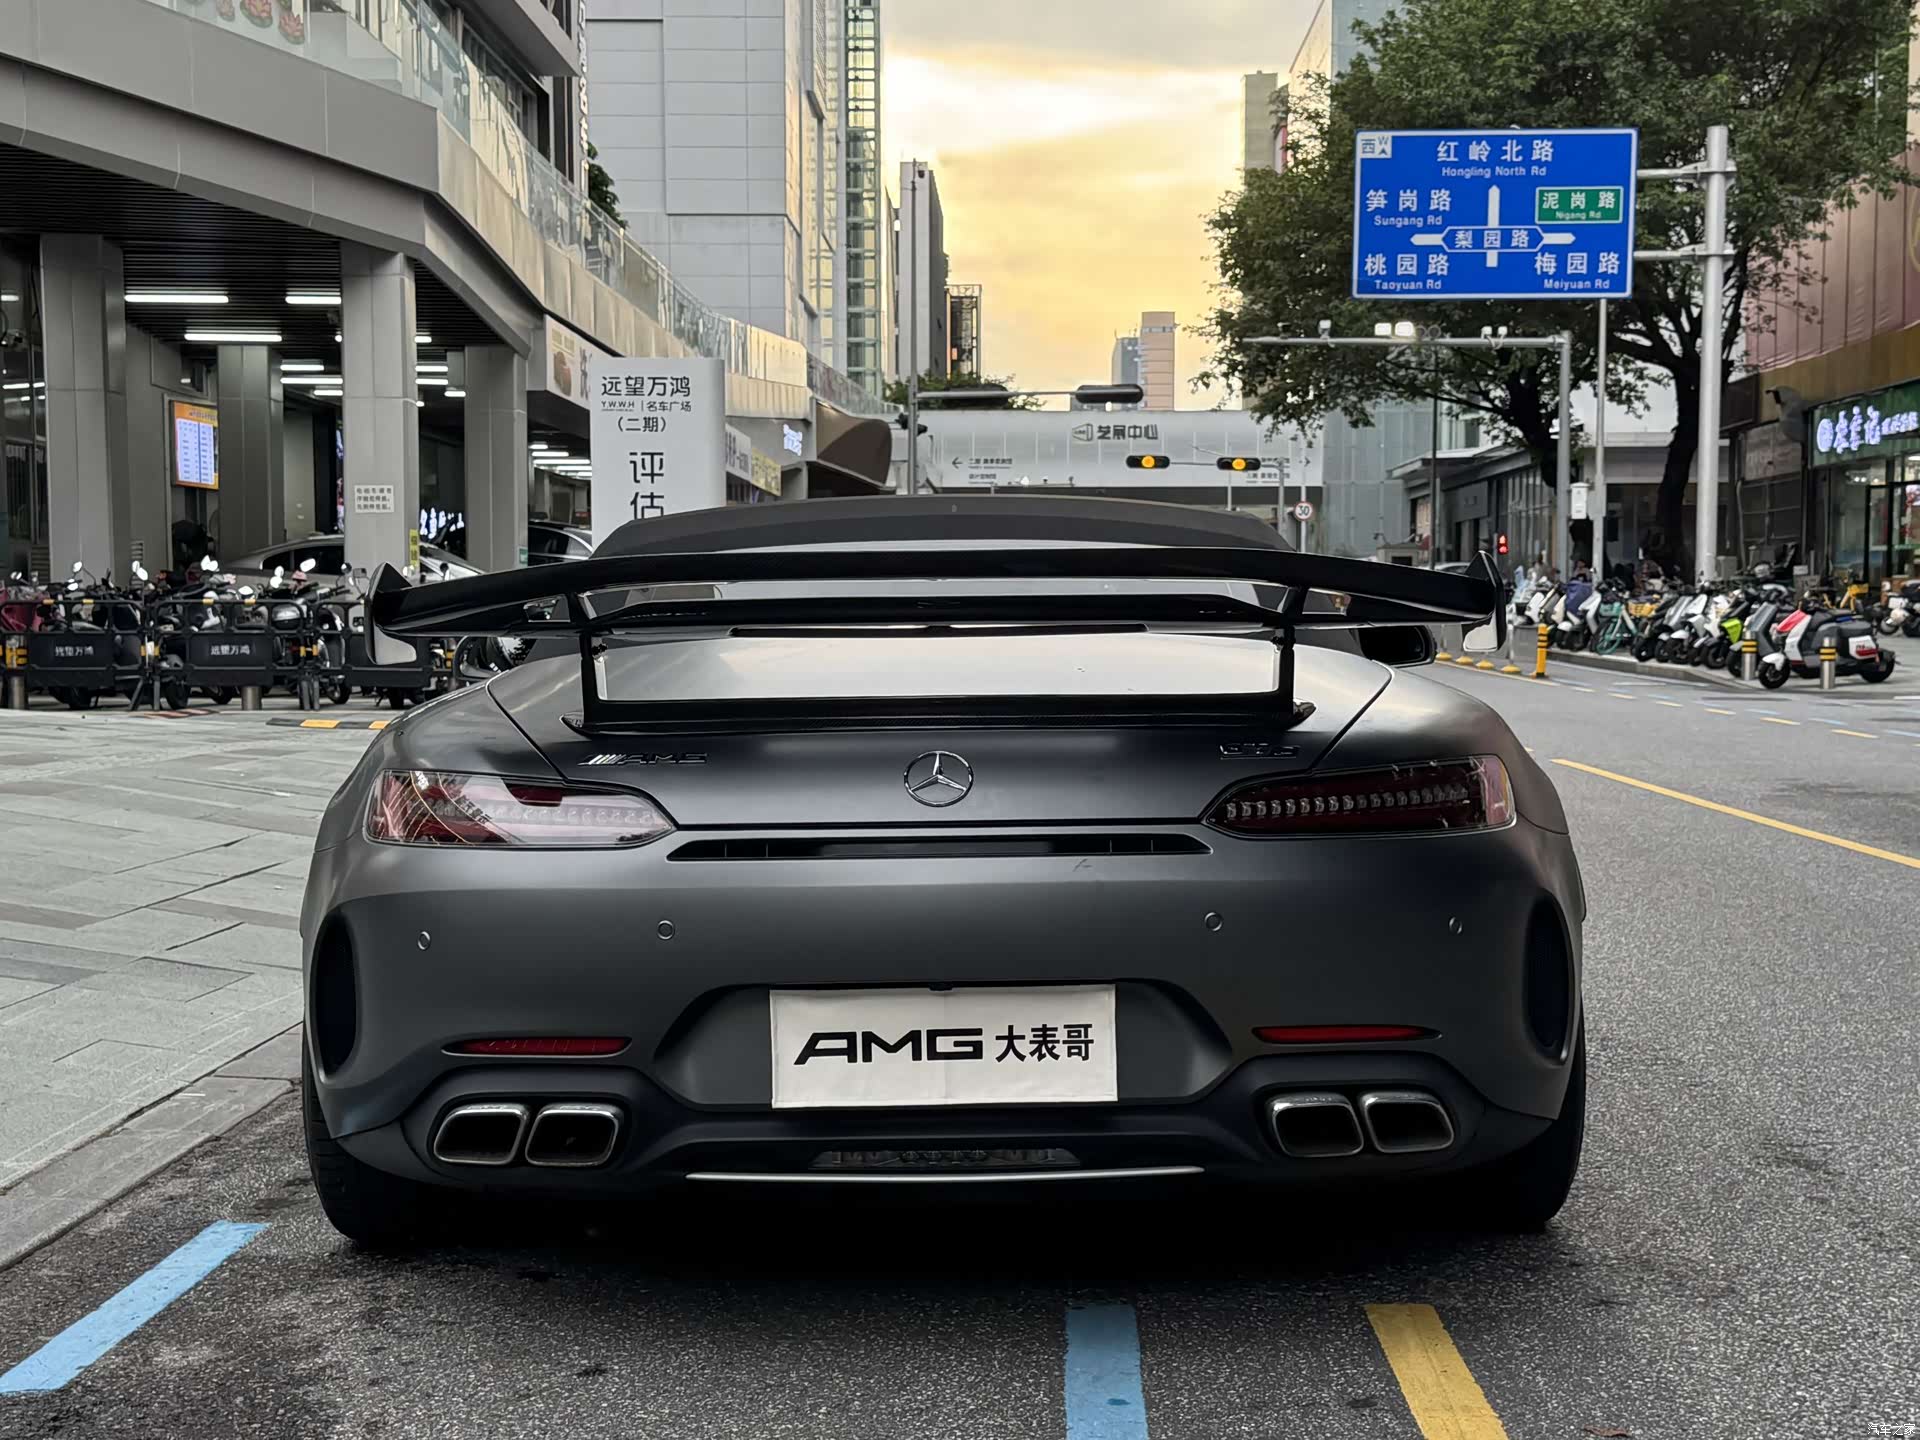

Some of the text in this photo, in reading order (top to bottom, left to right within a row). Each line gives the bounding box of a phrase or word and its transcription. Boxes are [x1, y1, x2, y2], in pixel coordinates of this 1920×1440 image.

[1361, 139, 1376, 154] 西
[1378, 136, 1389, 145] W
[1437, 140, 1554, 162] 红岭北路
[1442, 166, 1546, 178] Hongling North Rd
[1366, 189, 1451, 212] 笋岗路
[1542, 192, 1615, 210] 泥岗路
[1374, 215, 1442, 227] Sungang Rd
[1555, 211, 1602, 221] Nigang Rd
[1454, 230, 1529, 249] 梨园路
[1365, 253, 1449, 276] 桃园路
[1534, 252, 1620, 275] 梅园路
[1374, 280, 1441, 292] Taoyuan Rd
[1544, 278, 1610, 291] Meiyuan Rd
[601, 376, 691, 397] 远望万鸿
[646, 401, 692, 412] 名车广场
[618, 416, 666, 432] （二期）
[1097, 424, 1158, 440] 艺展中心
[629, 451, 665, 519] 评估
[1299, 505, 1310, 516] 30
[794, 1023, 1094, 1065] AMG 大表哥
